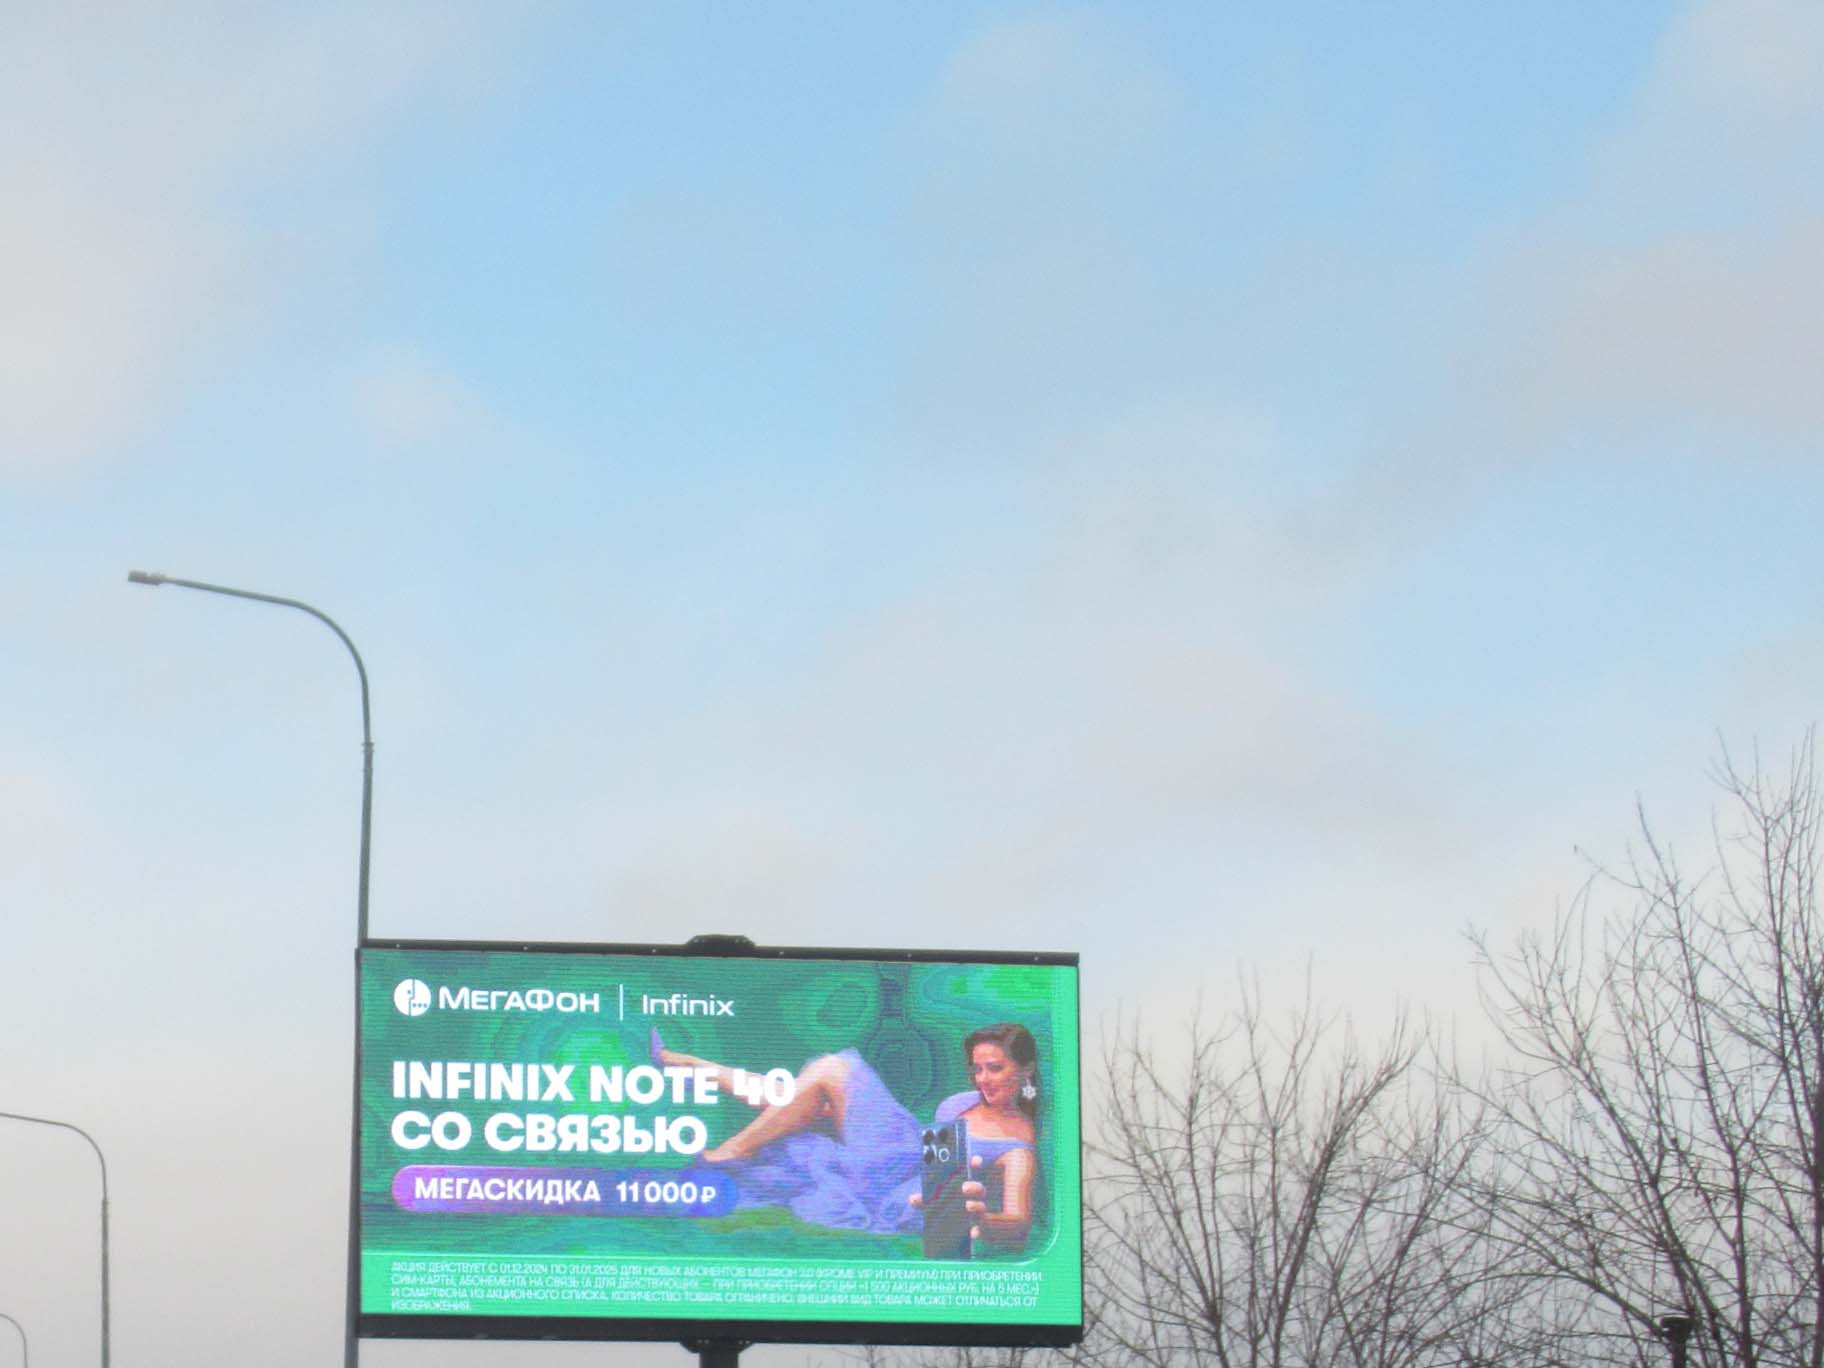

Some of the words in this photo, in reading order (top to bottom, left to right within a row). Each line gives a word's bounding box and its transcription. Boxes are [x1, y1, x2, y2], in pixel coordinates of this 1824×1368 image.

[642, 993, 735, 1016] Infinix
[393, 1061, 574, 1101] INFINIX
[590, 1066, 718, 1104] NOTE
[732, 1068, 802, 1107] 40
[391, 1110, 472, 1150] СО
[484, 1112, 708, 1155] СВЯЗЬЮ
[415, 1177, 601, 1205] МЕГАСКИДКА
